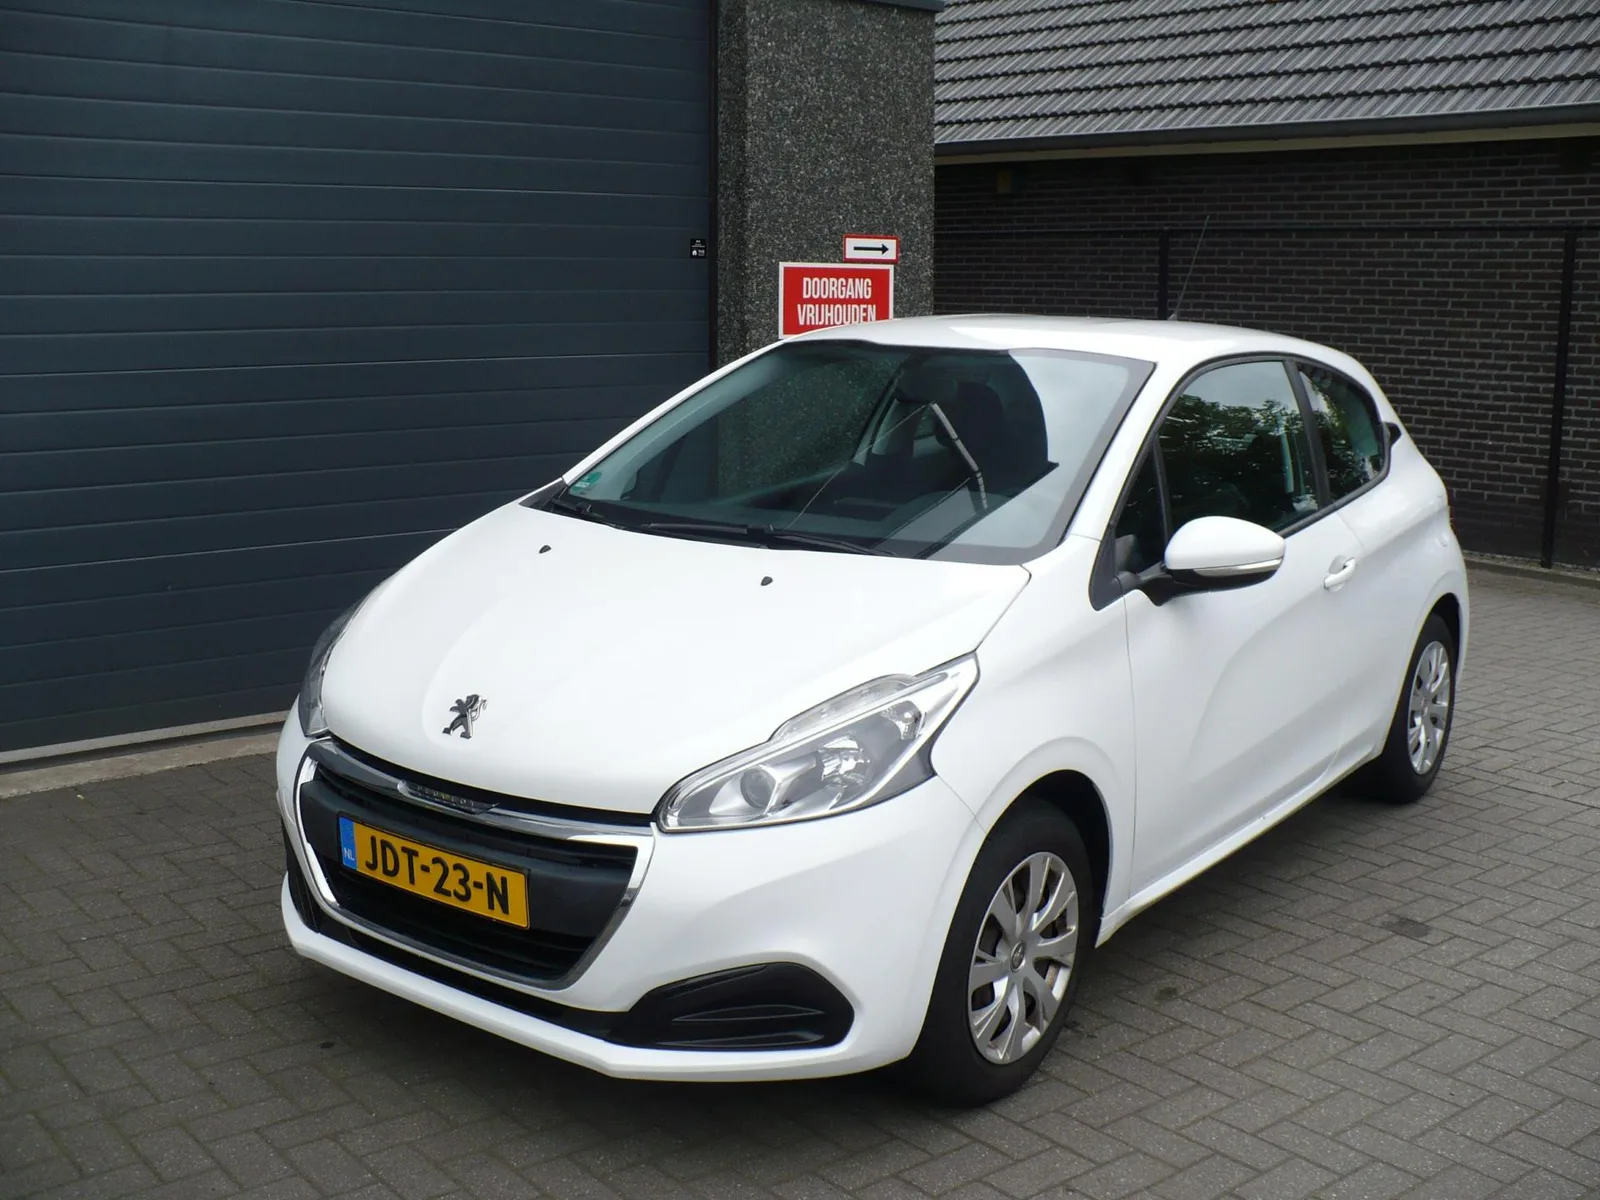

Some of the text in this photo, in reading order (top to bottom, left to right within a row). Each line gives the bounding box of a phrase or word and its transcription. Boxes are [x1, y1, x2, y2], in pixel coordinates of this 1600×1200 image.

[802, 277, 872, 299] DOORGANG
[797, 304, 876, 325] VRIJHOUDEN
[343, 835, 509, 915] NL JDT-23-N
